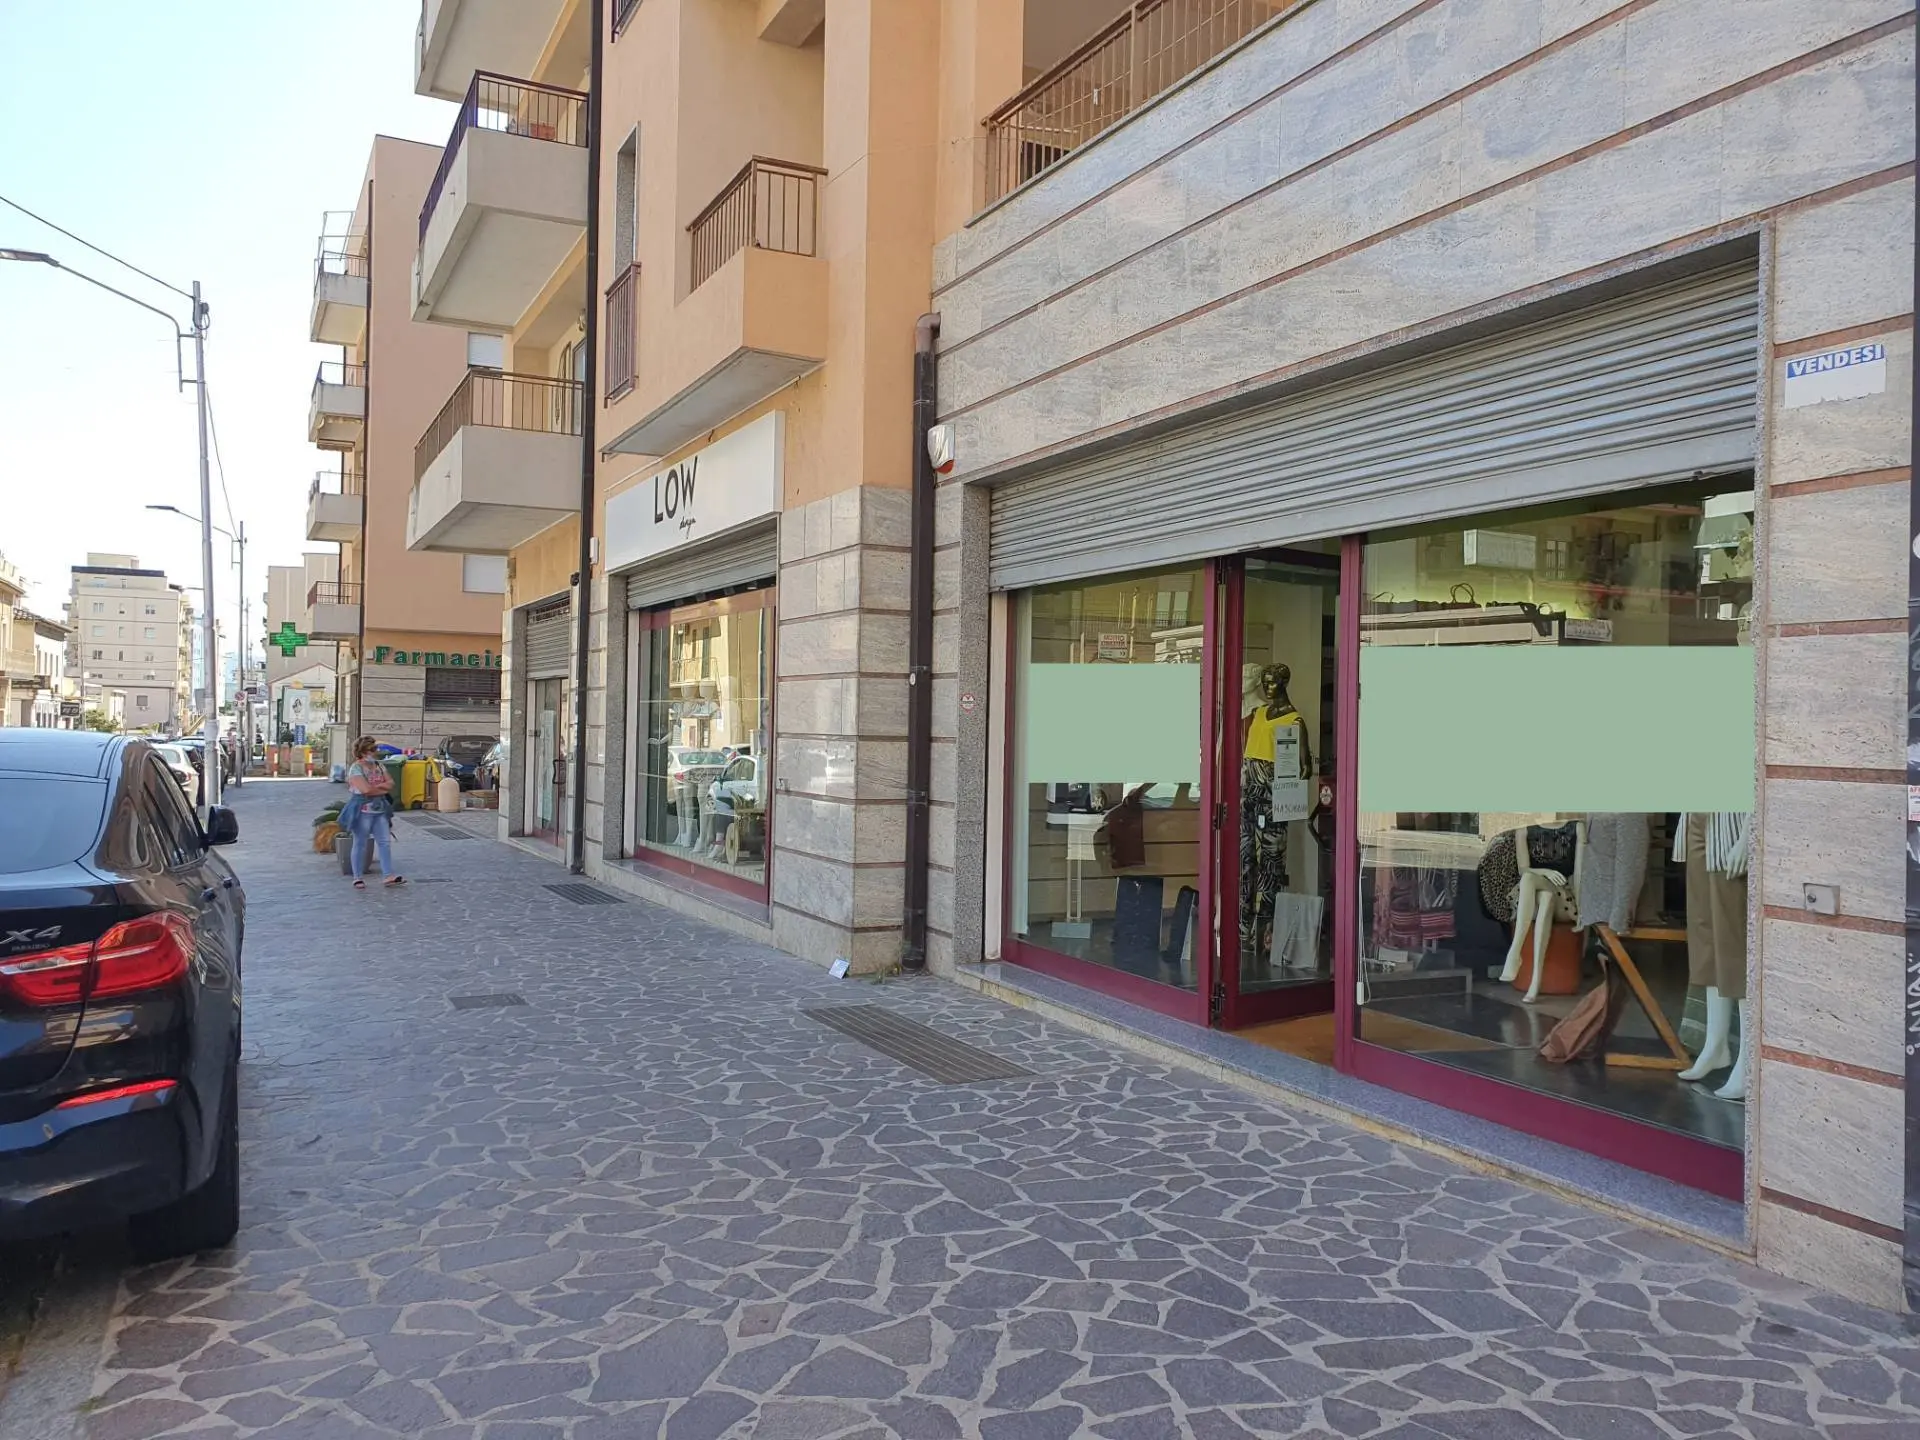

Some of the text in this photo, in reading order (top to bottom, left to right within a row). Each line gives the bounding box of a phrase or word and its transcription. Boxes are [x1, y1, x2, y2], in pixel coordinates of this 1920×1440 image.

[1791, 344, 1883, 376] VENDESI
[654, 455, 698, 524] LOW
[0, 925, 63, 944] X4
